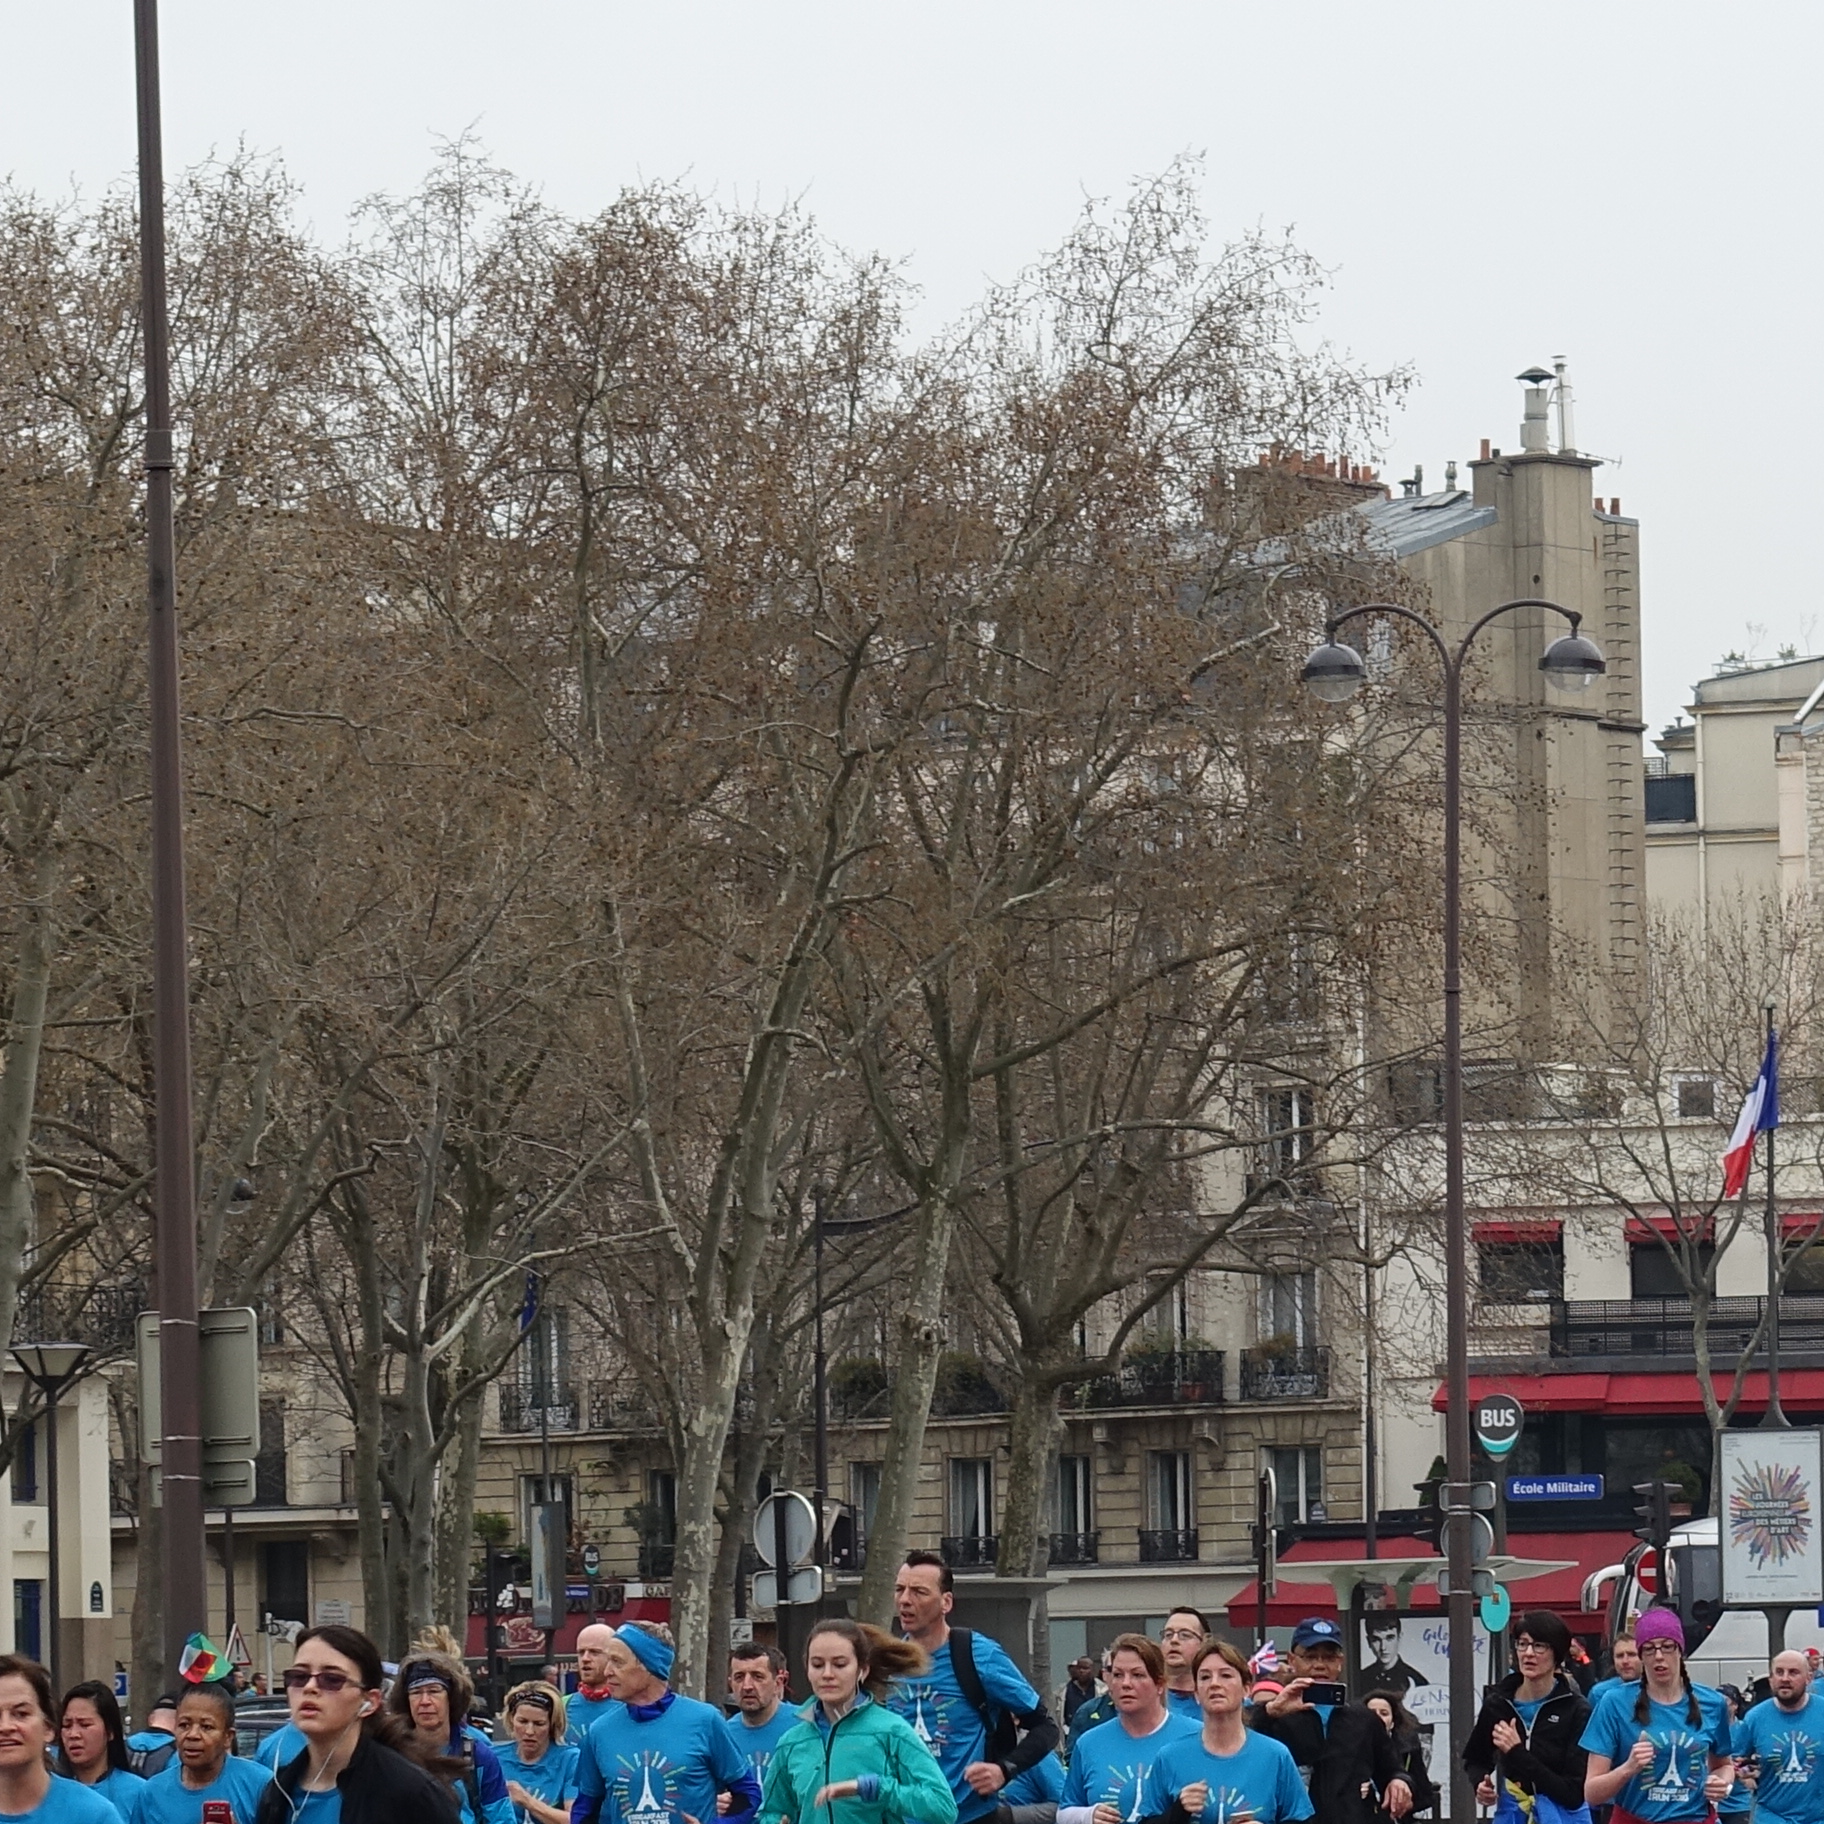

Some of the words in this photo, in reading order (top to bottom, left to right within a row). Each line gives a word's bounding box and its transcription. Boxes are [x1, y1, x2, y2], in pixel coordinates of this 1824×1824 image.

[1480, 1409, 1515, 1428] BUS
[1512, 1481, 1544, 1495] École
[1546, 1481, 1596, 1494] Militaire
